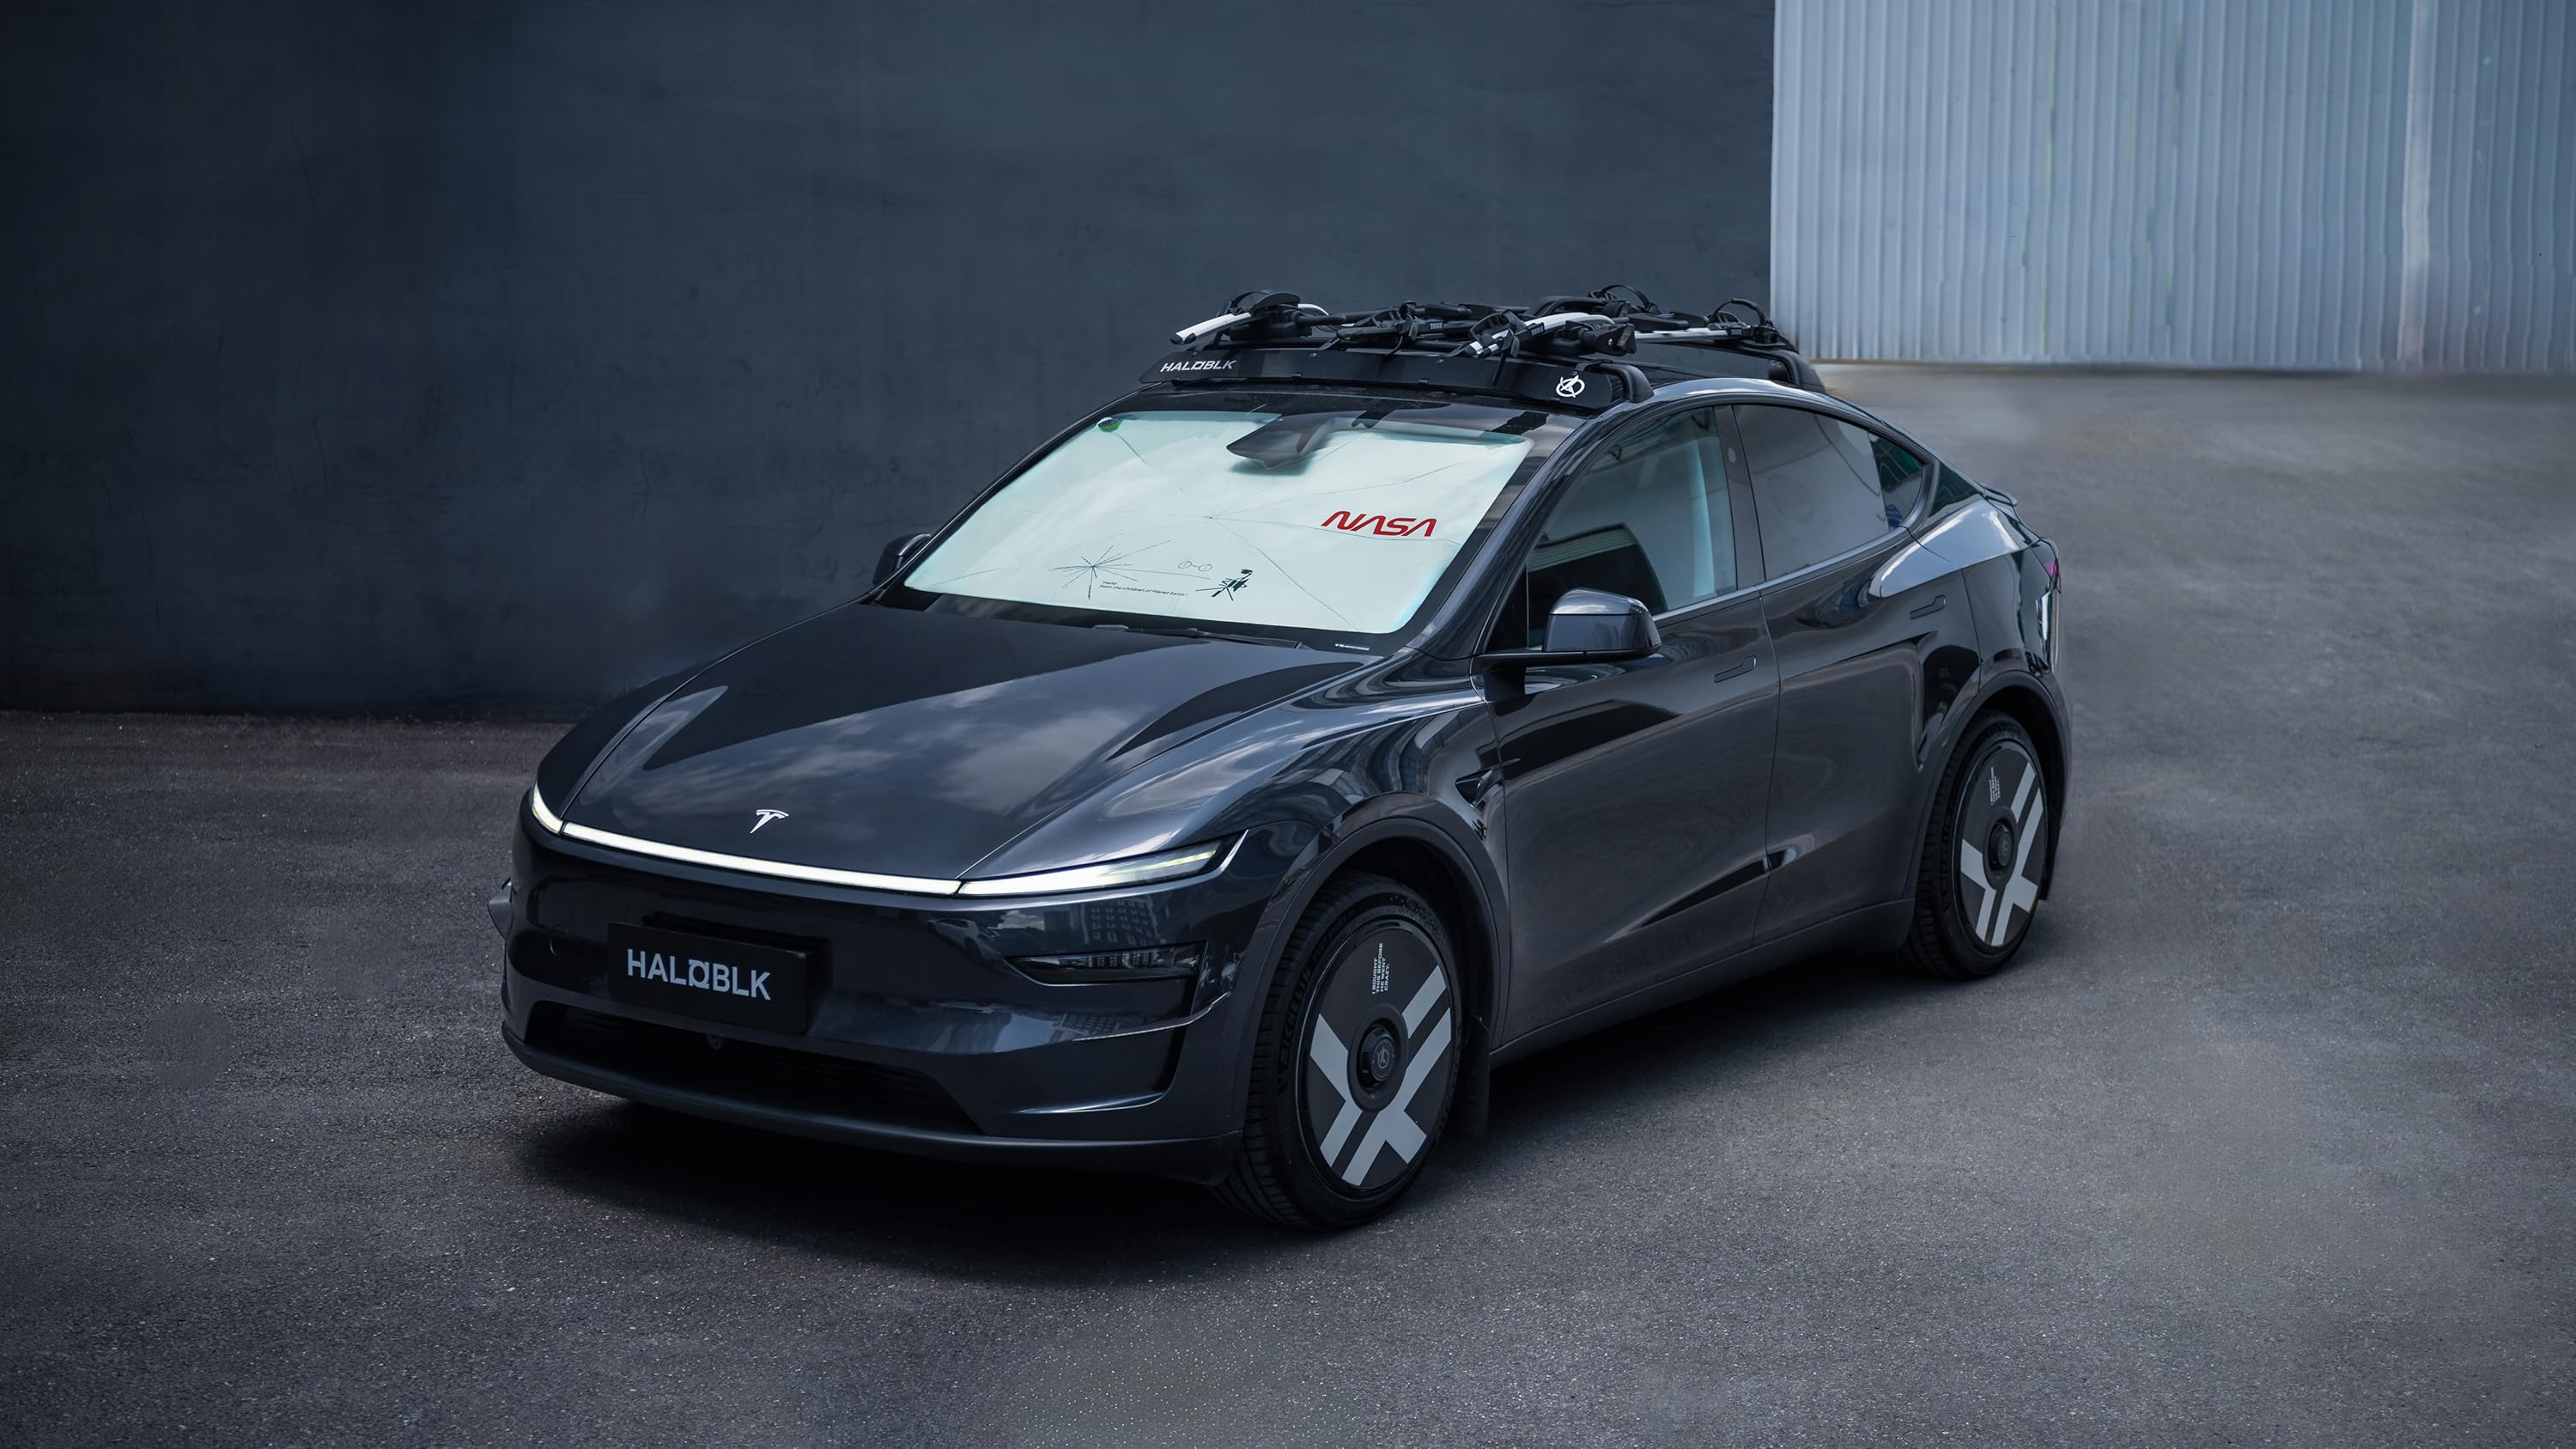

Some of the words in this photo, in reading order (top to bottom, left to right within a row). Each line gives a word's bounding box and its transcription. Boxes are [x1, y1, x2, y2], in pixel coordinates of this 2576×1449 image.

[1321, 510, 1437, 537] NASA
[628, 948, 771, 1001] HALOBLK
[1380, 981, 1385, 992] HE
